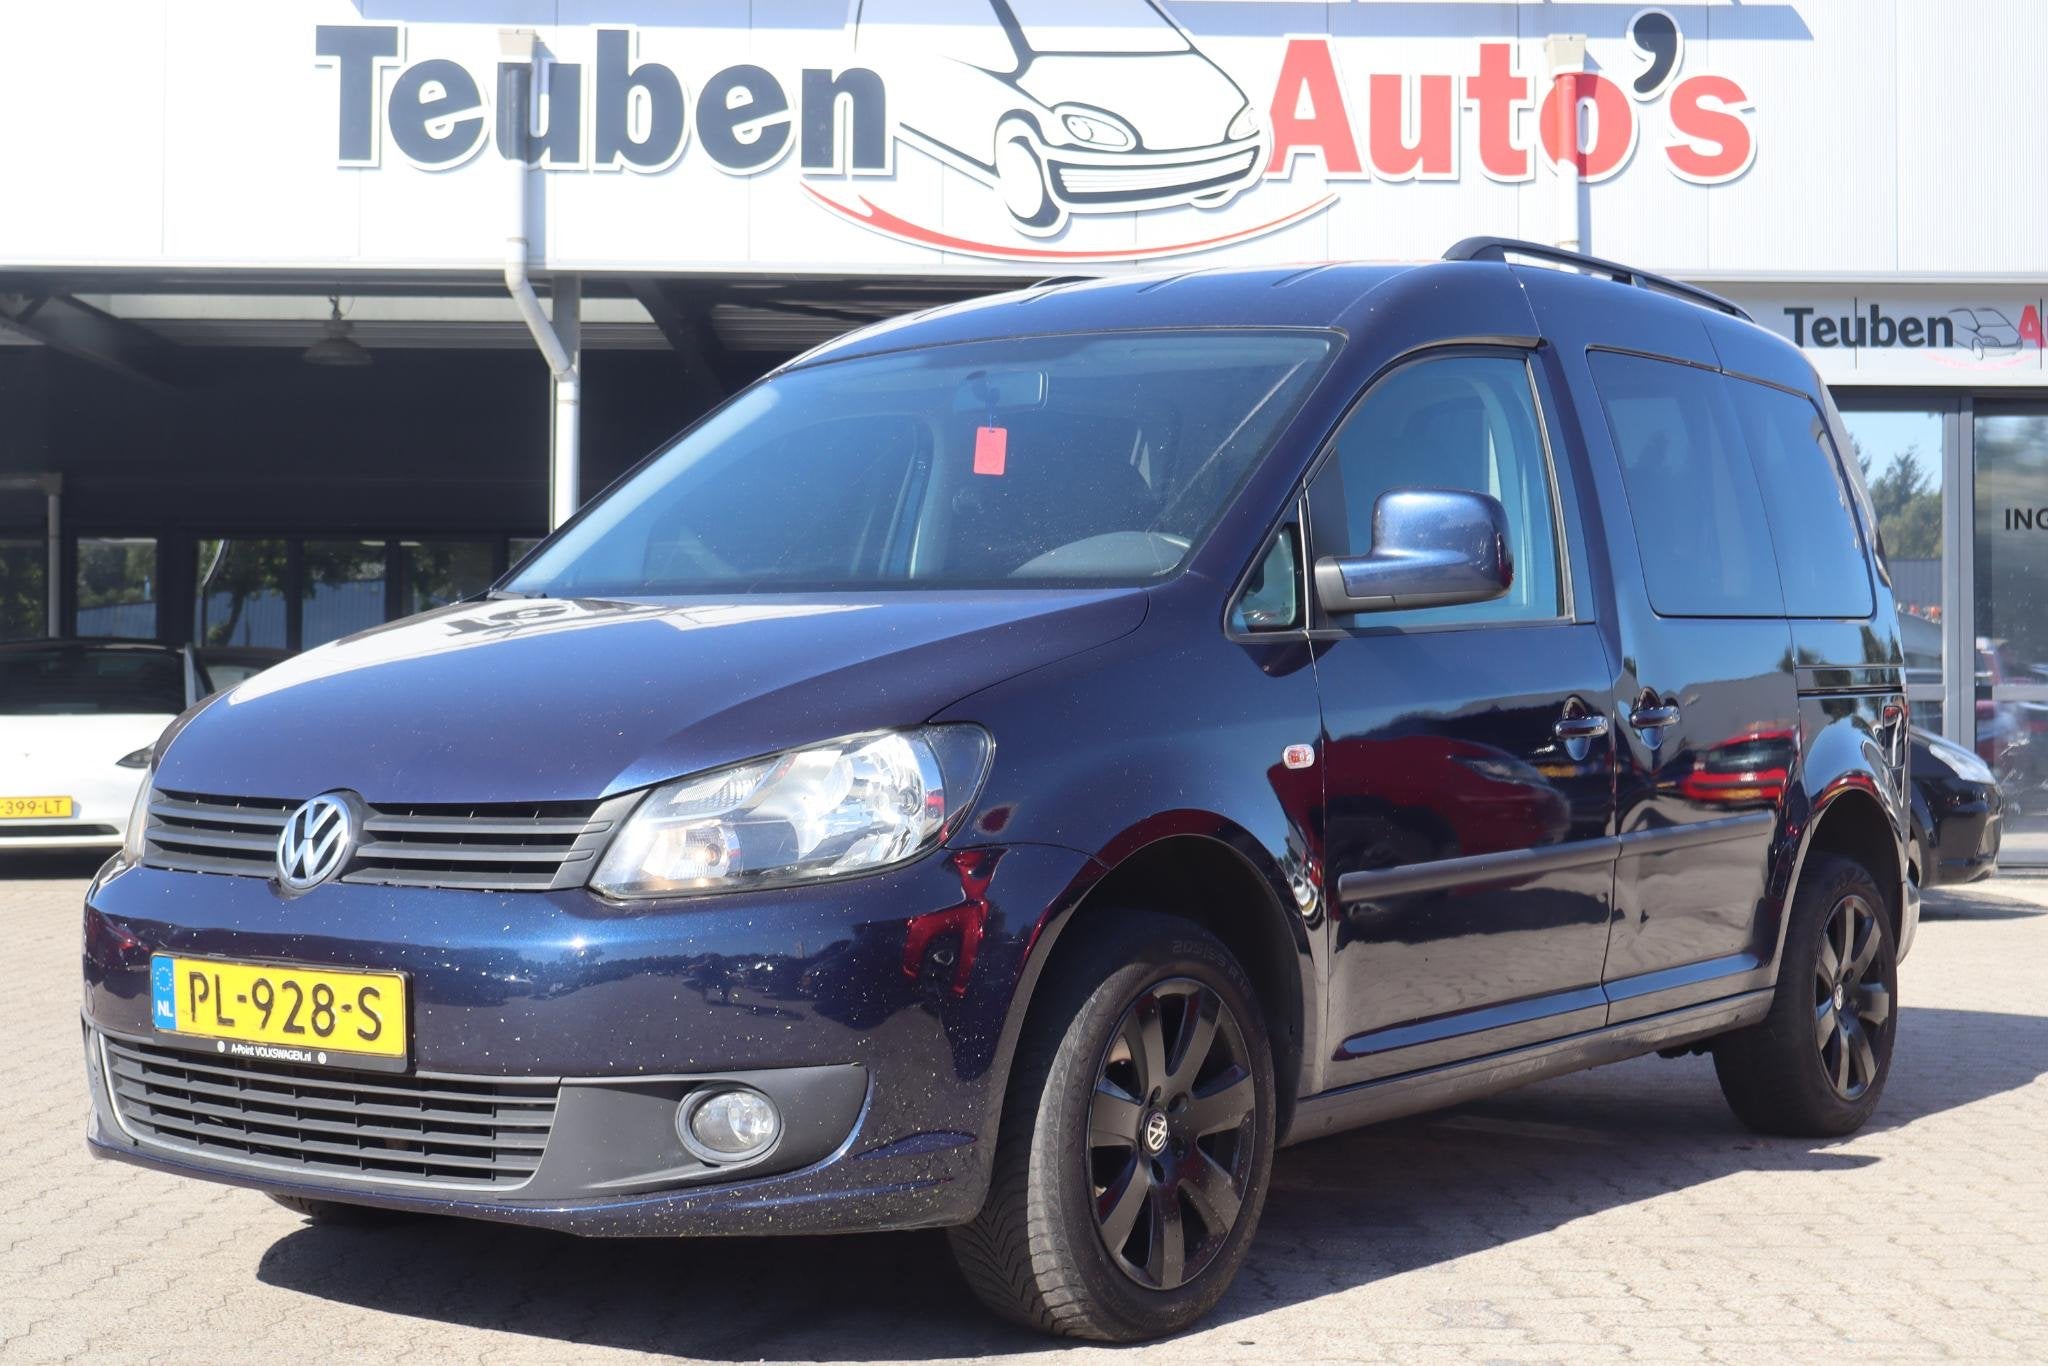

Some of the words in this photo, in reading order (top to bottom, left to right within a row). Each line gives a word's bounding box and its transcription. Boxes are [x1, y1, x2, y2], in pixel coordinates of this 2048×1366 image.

[314, 23, 888, 172] Teuben
[1264, 11, 1754, 181] Auto's
[1783, 303, 1954, 348] Teuben
[157, 1000, 175, 1018] NL
[188, 971, 383, 1042] PL-928-S
[255, 1046, 312, 1062] VOLKSWAGEN.nl
